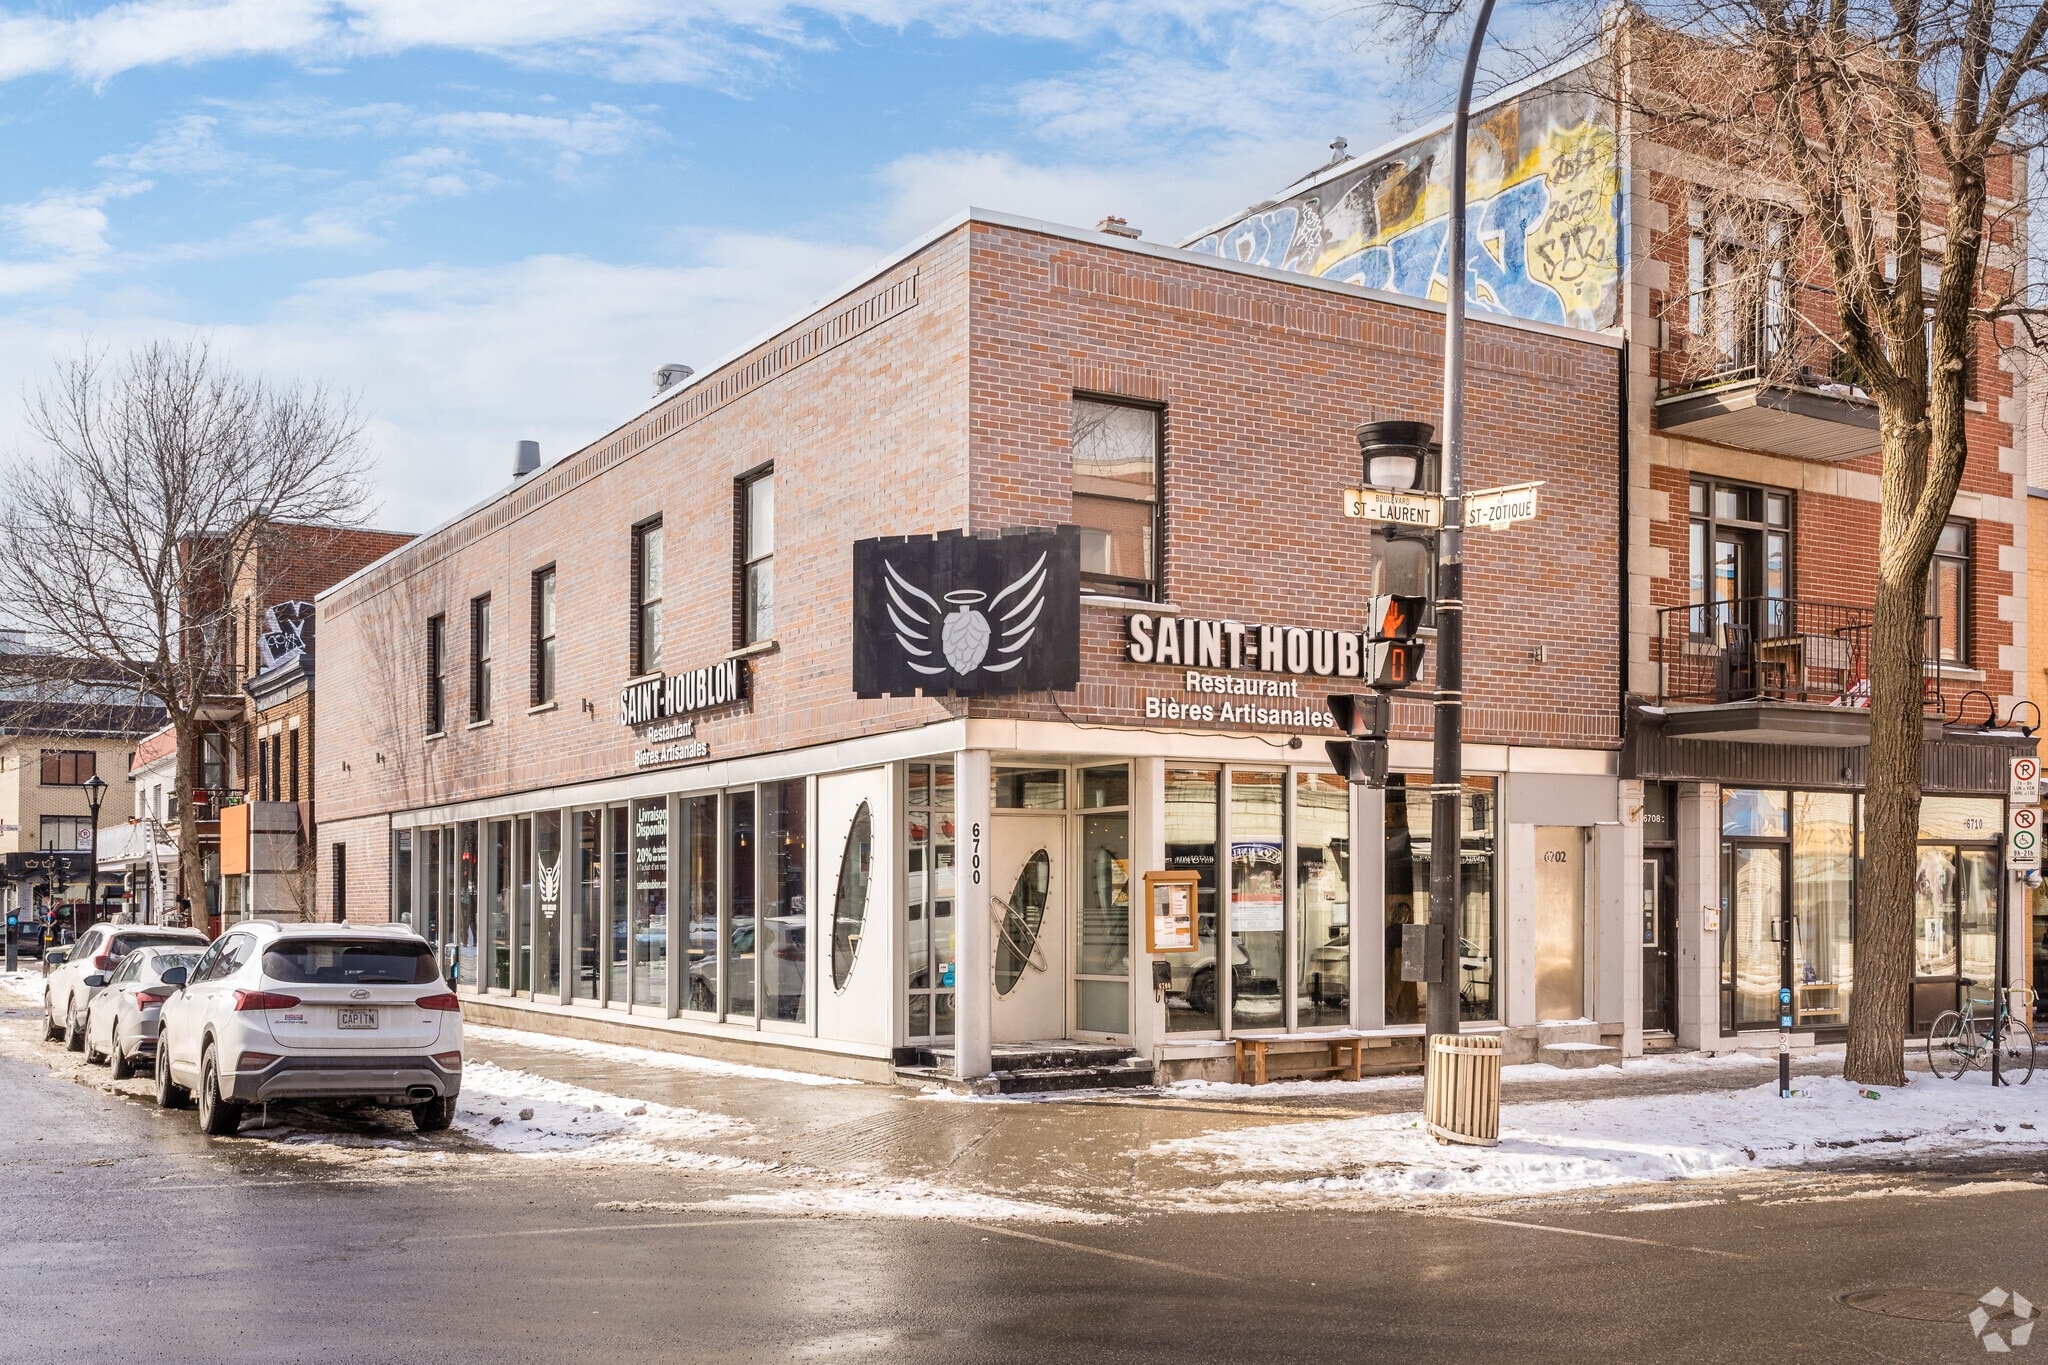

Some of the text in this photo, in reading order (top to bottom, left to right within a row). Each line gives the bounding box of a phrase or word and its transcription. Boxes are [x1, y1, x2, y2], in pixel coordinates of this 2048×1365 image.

[1545, 190, 1594, 233] 2022
[1375, 494, 1410, 505] BOULEVARD
[1469, 501, 1532, 524] ST-ZOTIQUE
[1129, 614, 1368, 678] SAINT-HOUB
[620, 659, 737, 726] SAINT-HOUBLON
[1186, 671, 1298, 698] Restaurant
[1145, 696, 1334, 728] Bières Artisanales
[648, 720, 693, 743] Restaurant
[634, 740, 707, 767] Bières Artisanales
[1966, 818, 1983, 829] 6710
[636, 847, 653, 863] 20%
[972, 822, 981, 885] 6700
[342, 1013, 375, 1024] CAPITN
